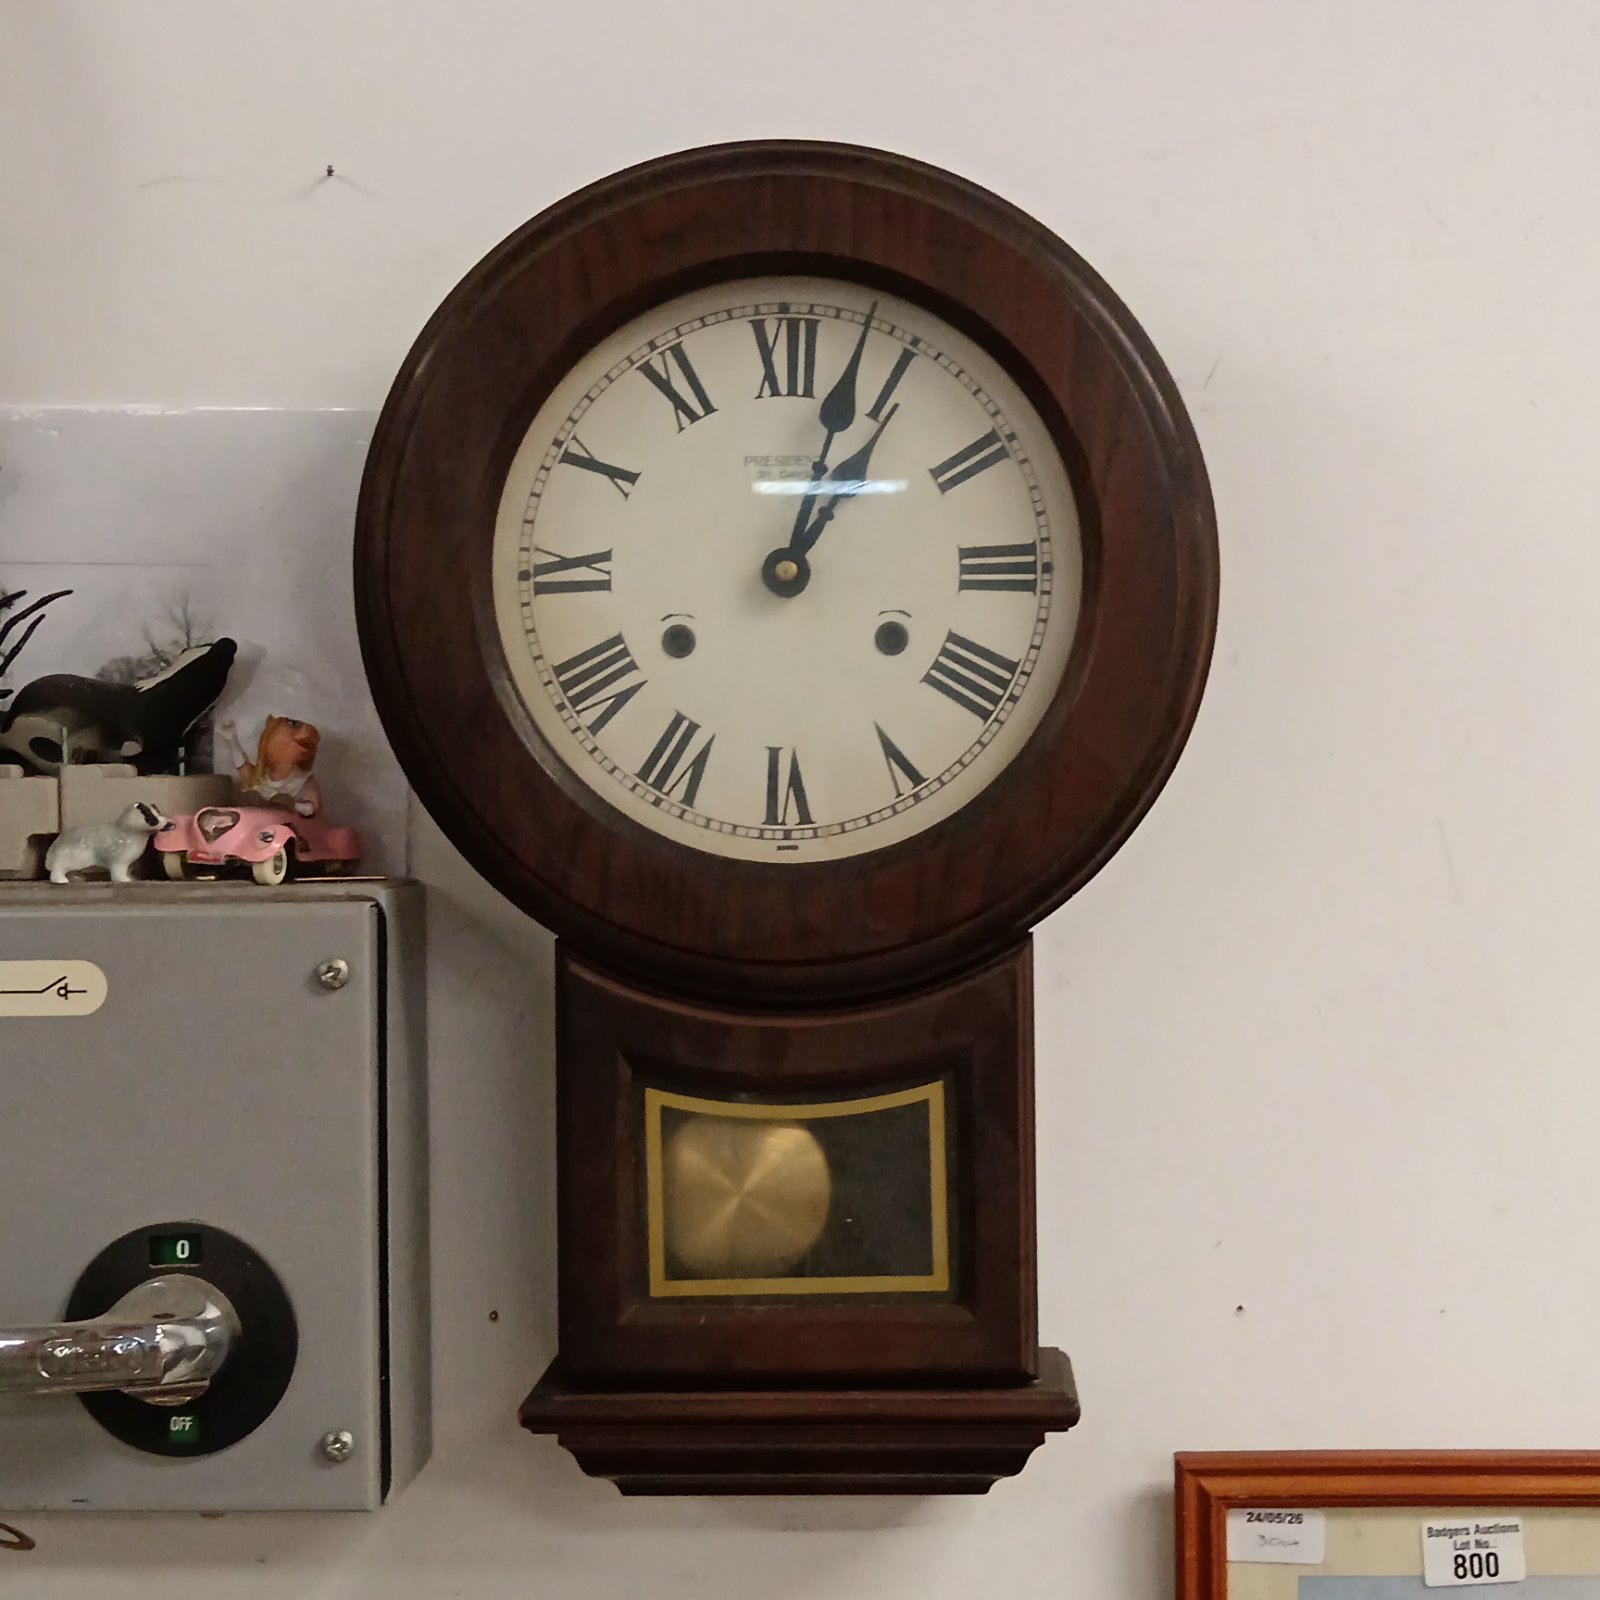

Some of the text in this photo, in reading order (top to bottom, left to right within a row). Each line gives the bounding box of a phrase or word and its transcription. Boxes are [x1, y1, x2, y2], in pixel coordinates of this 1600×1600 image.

[635, 341, 719, 433] XI
[748, 317, 822, 399] XII
[864, 348, 918, 424] I
[557, 435, 642, 501] X
[928, 427, 1011, 495] II
[532, 545, 612, 596] IX
[958, 540, 1038, 594] III
[551, 632, 648, 735] VIII
[919, 629, 1020, 726] IIII
[633, 709, 716, 808] VII
[761, 746, 816, 826] VI
[873, 721, 930, 798] V
[170, 1417, 193, 1431] OFF
[1453, 1540, 1470, 1551] Lot
[1454, 1552, 1499, 1579] 800
